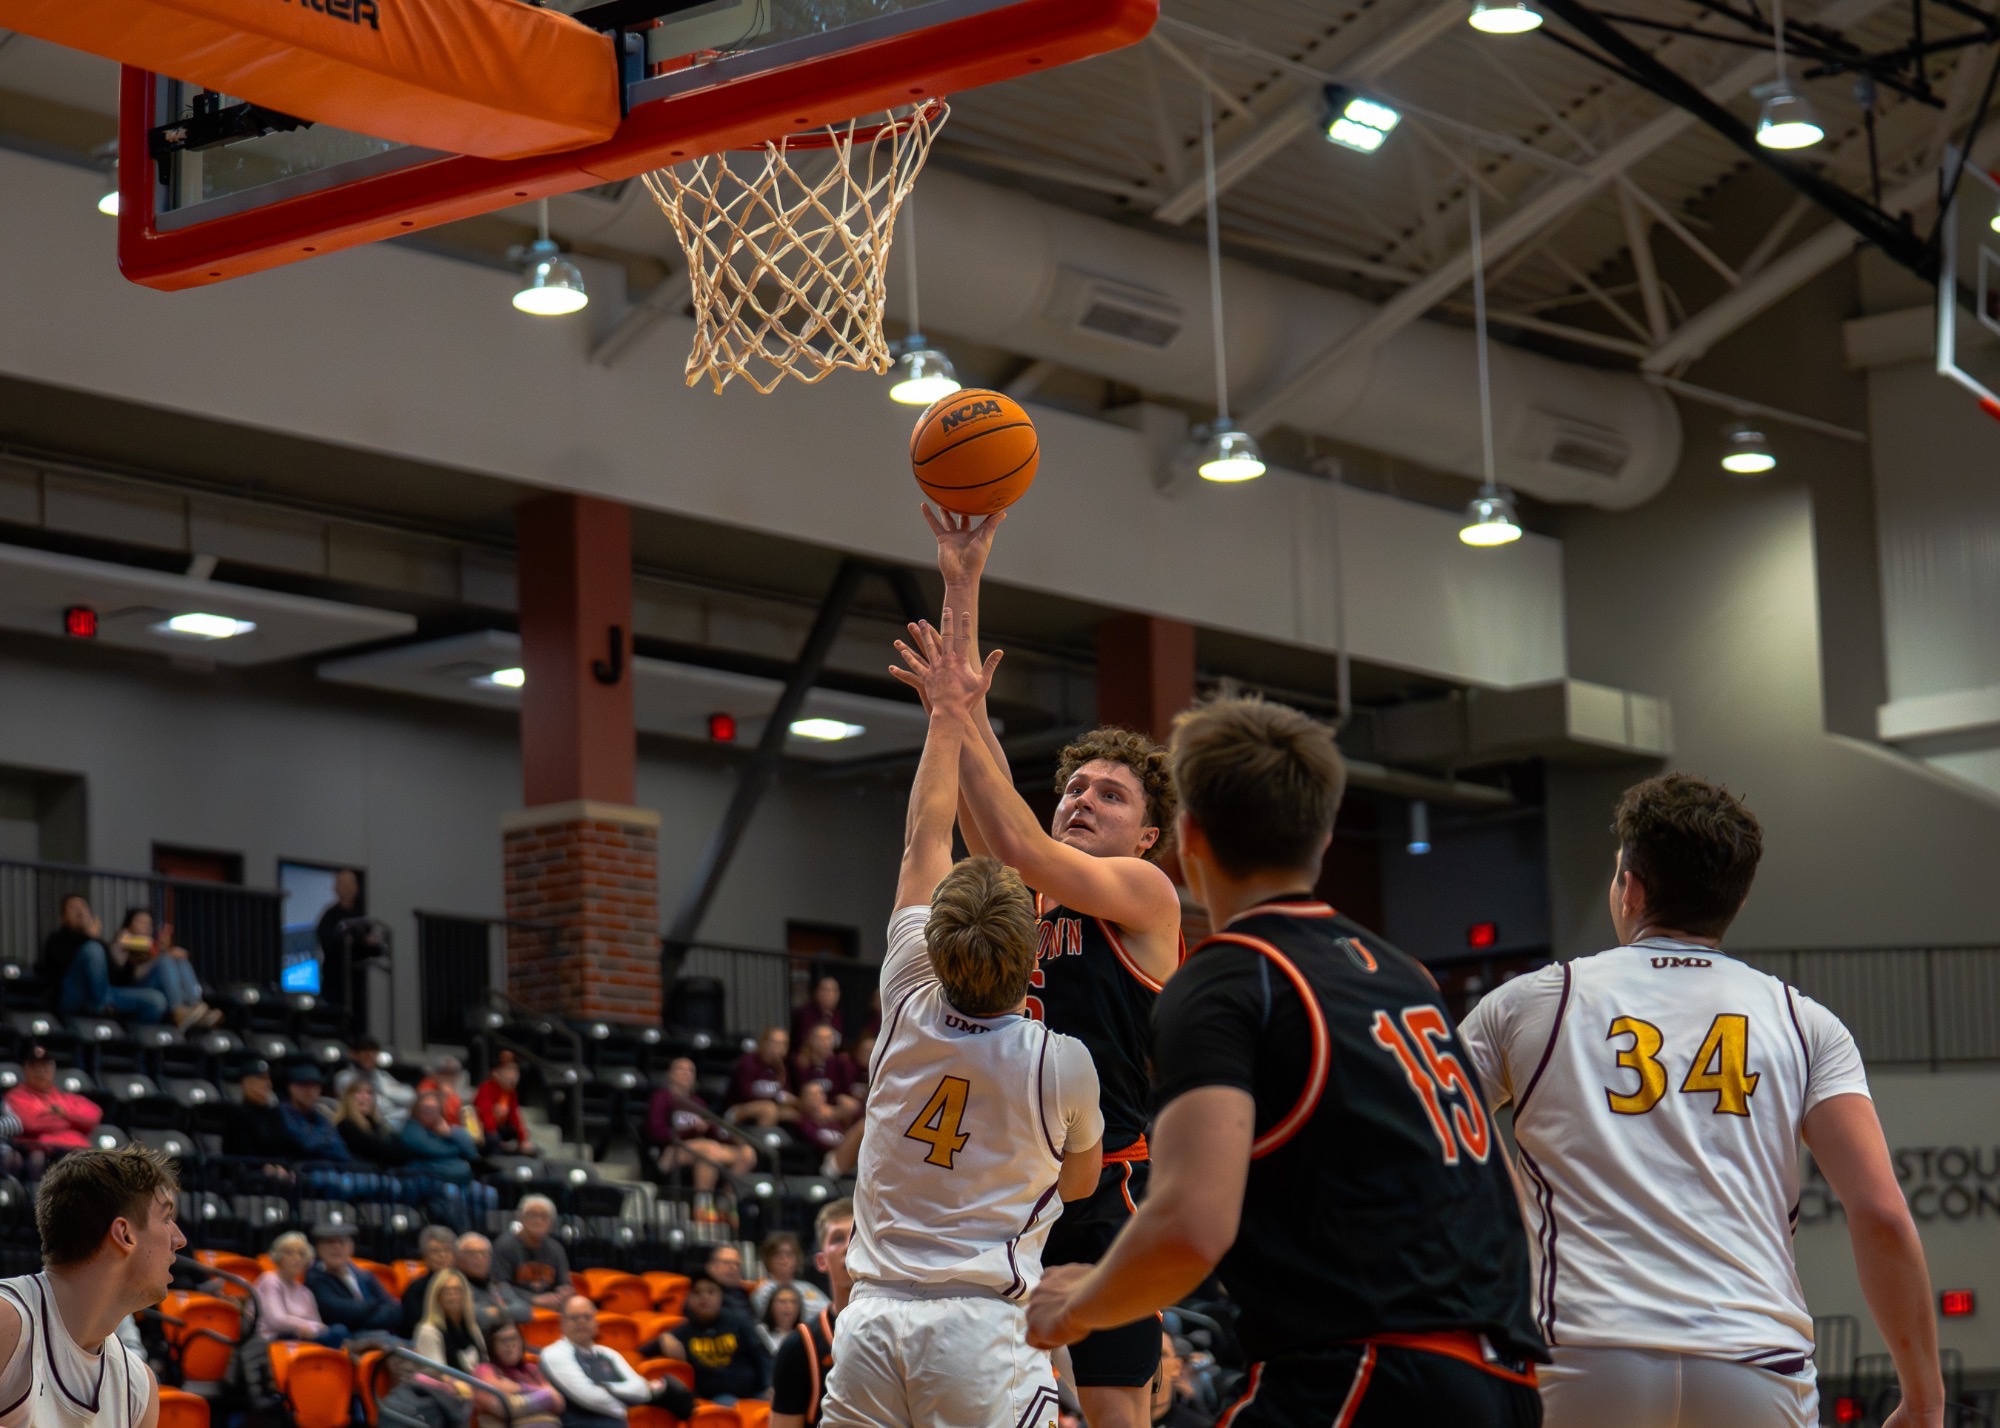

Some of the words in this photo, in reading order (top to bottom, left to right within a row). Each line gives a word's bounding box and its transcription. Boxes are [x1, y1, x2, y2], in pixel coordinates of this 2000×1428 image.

[941, 400, 1002, 433] NCAA
[593, 624, 623, 687] J
[1650, 956, 1713, 969] UMD
[1370, 1004, 1491, 1166] 15
[1604, 1013, 1760, 1118] 34
[903, 1074, 971, 1170] 4
